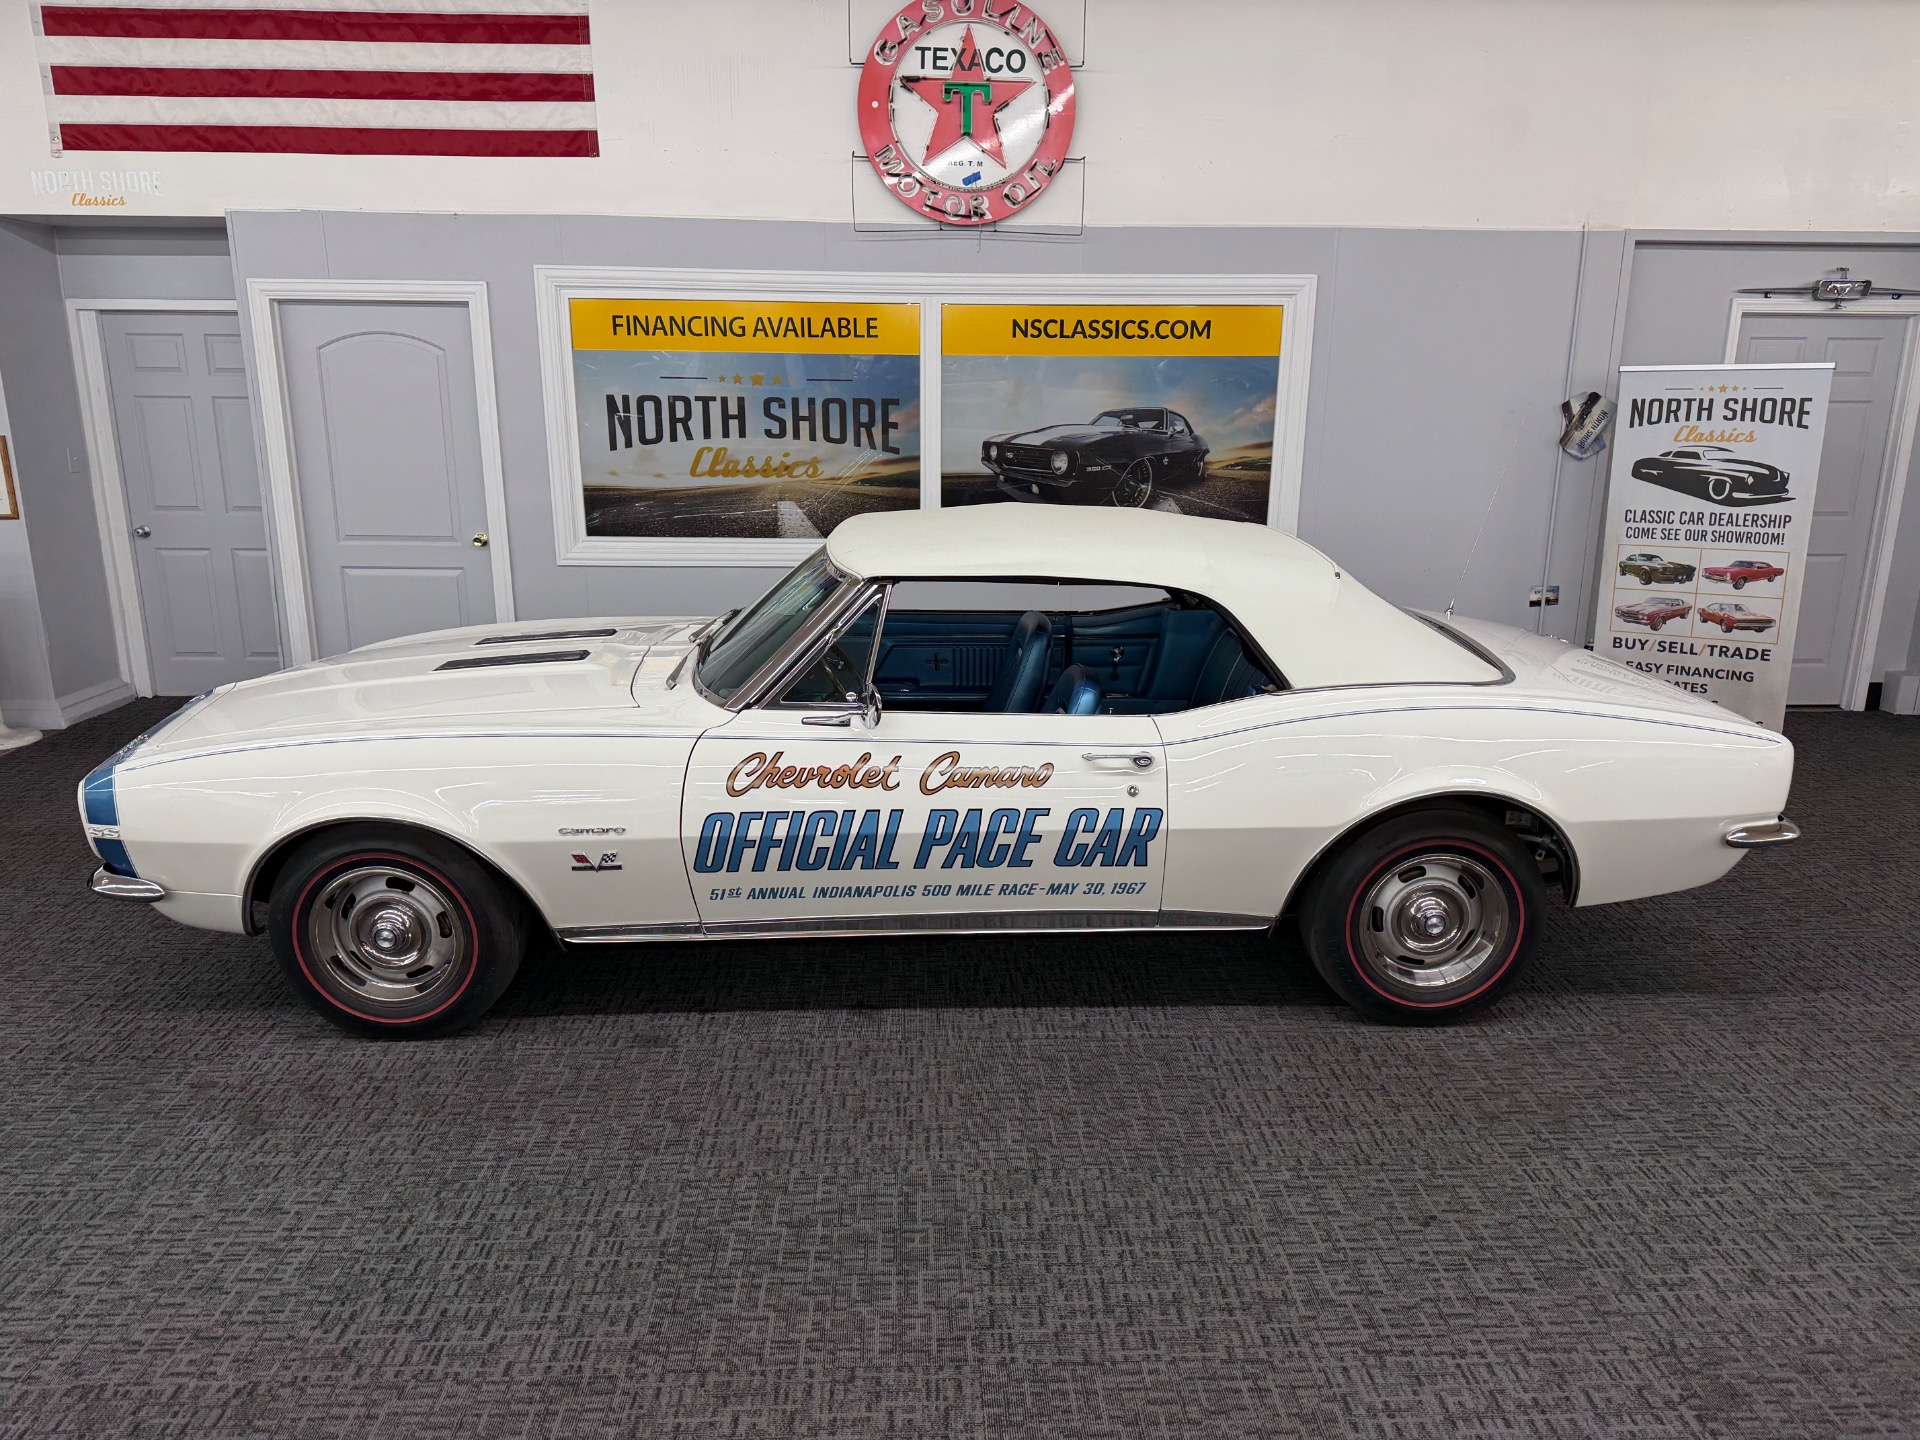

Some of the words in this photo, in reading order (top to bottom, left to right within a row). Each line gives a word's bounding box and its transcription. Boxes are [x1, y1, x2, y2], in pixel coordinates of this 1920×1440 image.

[914, 46, 1027, 74] TEXACO
[942, 81, 992, 138] T
[30, 170, 94, 197] NORTH
[99, 170, 164, 197] SHORE
[874, 144, 993, 222] MOTOR
[1003, 159, 1059, 209] OIL
[71, 192, 127, 207] Classics
[611, 315, 746, 338] FINANCING
[752, 317, 879, 339] AVAILABLE
[1012, 318, 1212, 340] NSCLASSICS.COM
[605, 394, 747, 451] NORTH
[763, 396, 900, 455] SHORE
[1629, 397, 1713, 429] NORTH
[1722, 397, 1813, 430] SHORE
[1673, 425, 1758, 444] Classics
[689, 446, 825, 479] Classics
[1624, 509, 1676, 526] CLASSIC
[1679, 512, 1705, 527] CAR
[1708, 513, 1792, 530] DEALERSHIP
[1625, 526, 1658, 541] COME
[1660, 528, 1681, 542] SEE
[1684, 529, 1708, 543] OUR
[1710, 530, 1785, 546] SHOWROOM!
[1612, 636, 1772, 662] BUY/SELL/TRADE
[1666, 664, 1755, 683] FINANCING
[726, 751, 902, 797] Chevrolet
[919, 751, 1055, 796] Camaro
[88, 827, 121, 838] SS
[693, 809, 904, 873] OFFICIAL
[913, 808, 1051, 870] PACE
[1053, 807, 1163, 868] CAR
[747, 886, 806, 900] ANNUAL
[812, 884, 917, 899] INDIANAPOLIS
[921, 884, 952, 897] 500
[955, 882, 995, 896] MILE
[1082, 882, 1106, 897] 30,
[1110, 881, 1147, 895] 1967
